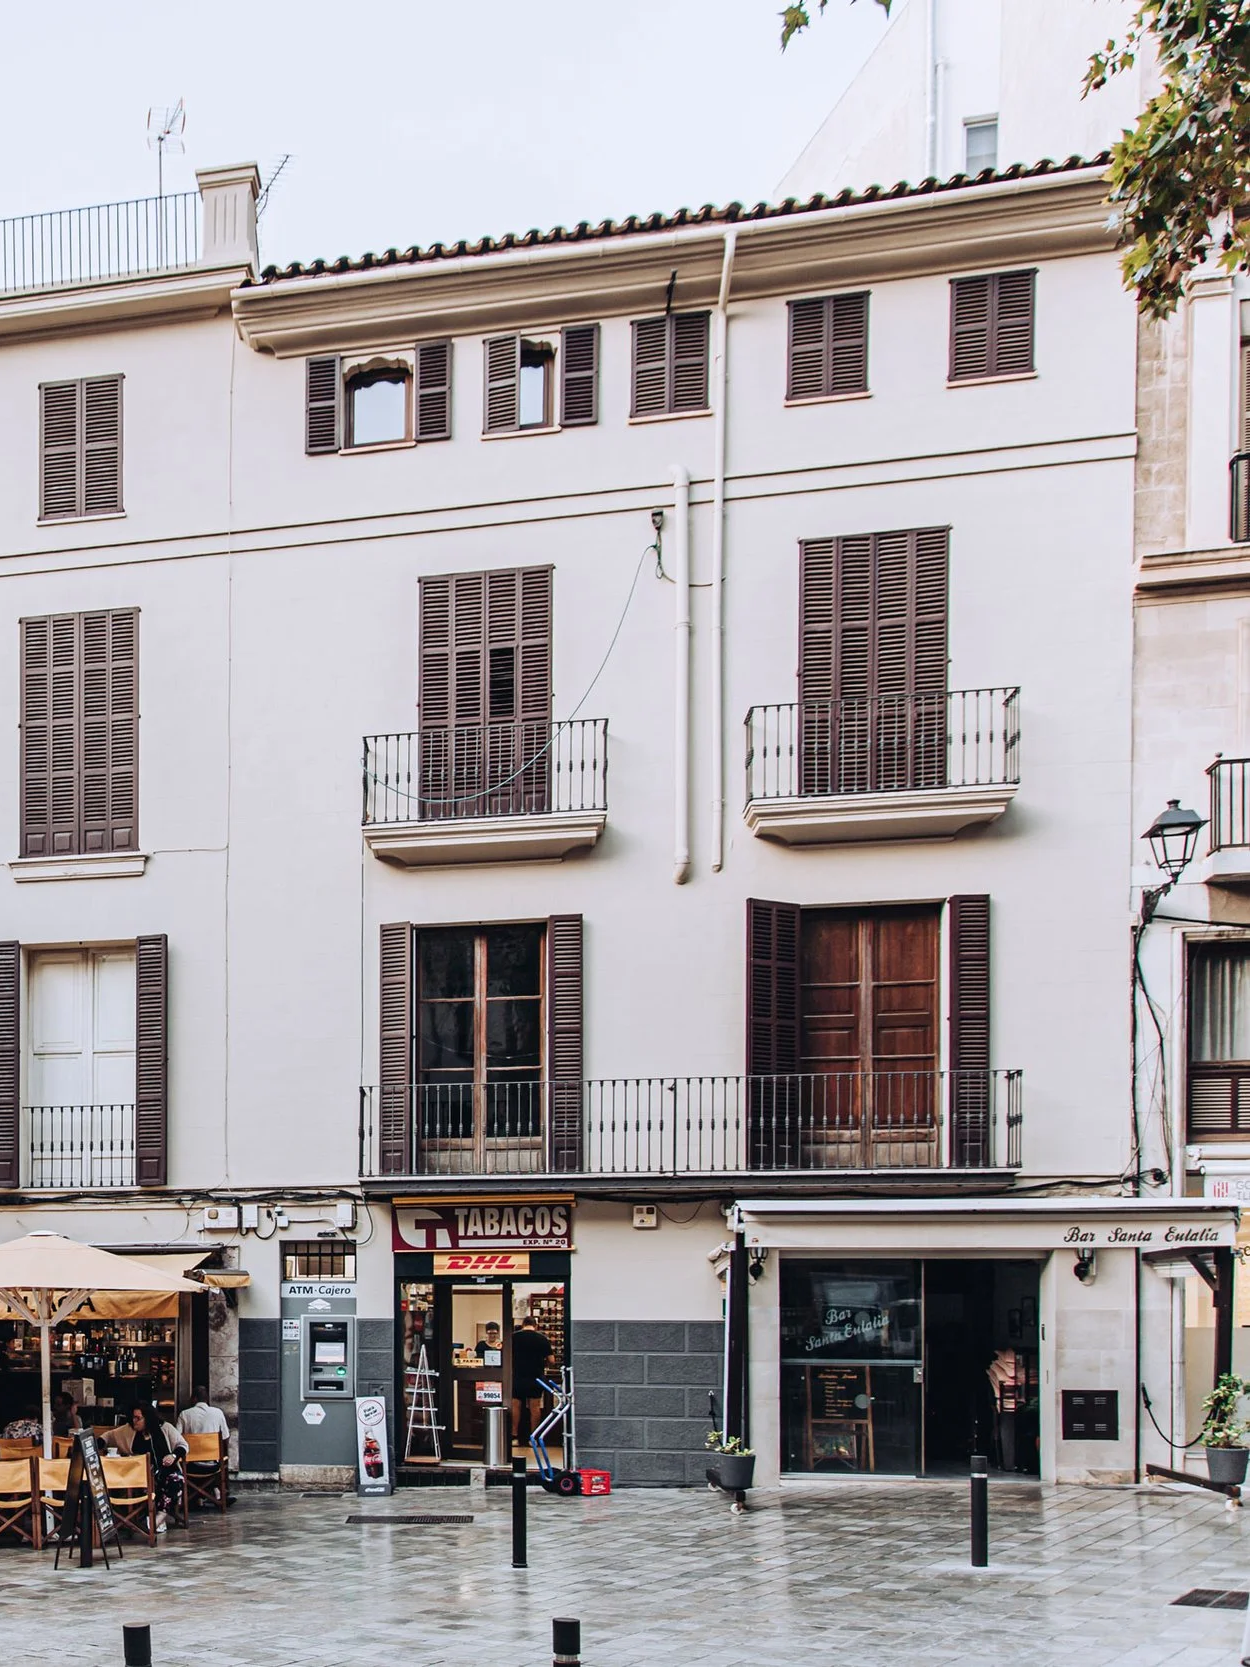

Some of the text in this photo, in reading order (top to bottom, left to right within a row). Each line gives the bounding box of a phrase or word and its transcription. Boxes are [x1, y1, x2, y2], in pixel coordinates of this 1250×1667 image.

[454, 1206, 568, 1237] TABACOS
[554, 1238, 567, 1246] 20
[1063, 1225, 1220, 1243] Bar Santa Eulalia
[446, 1255, 517, 1270] DHL
[318, 1285, 352, 1297] Cajero
[825, 1308, 852, 1325] Bar
[805, 1314, 890, 1352] Santa Eulalia
